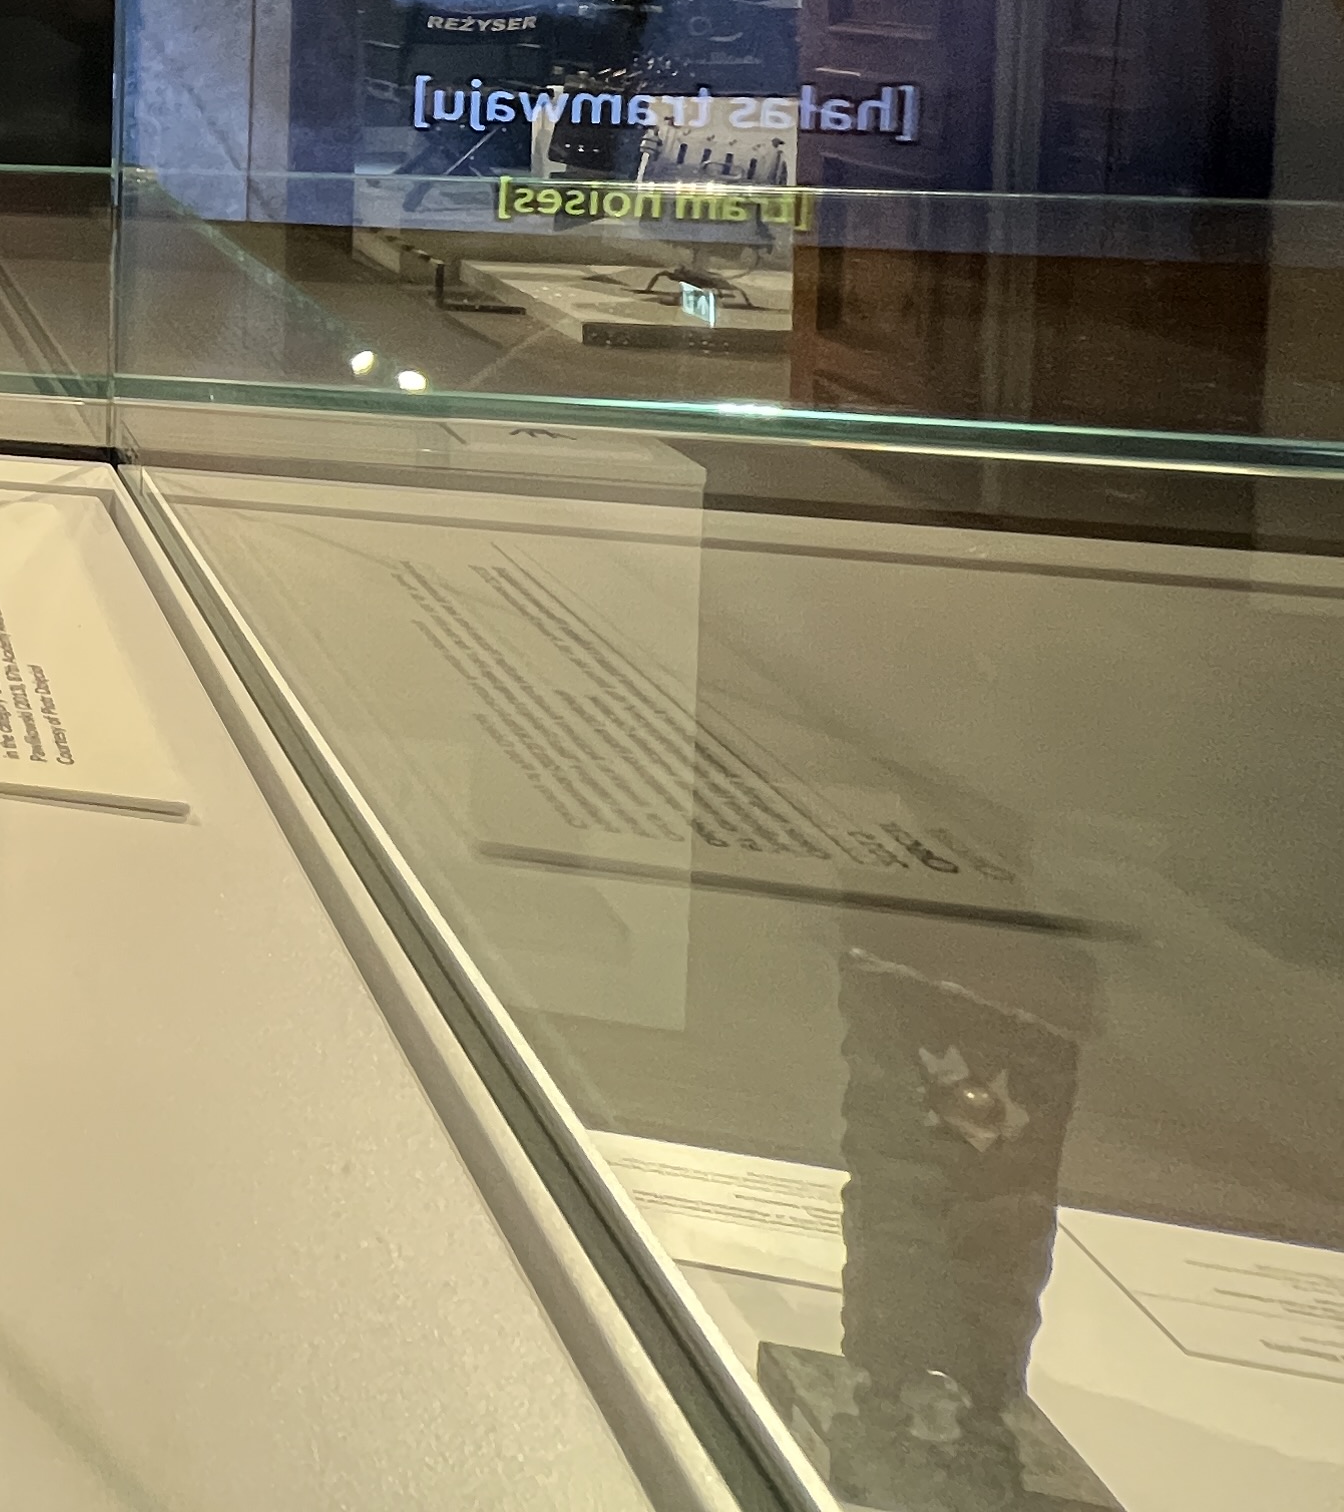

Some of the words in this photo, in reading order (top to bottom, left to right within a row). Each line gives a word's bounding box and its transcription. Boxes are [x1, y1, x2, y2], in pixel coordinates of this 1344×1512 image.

[426, 15, 538, 33] REŻYSER
[43, 715, 61, 725] of
[51, 726, 74, 765] Courtesy
